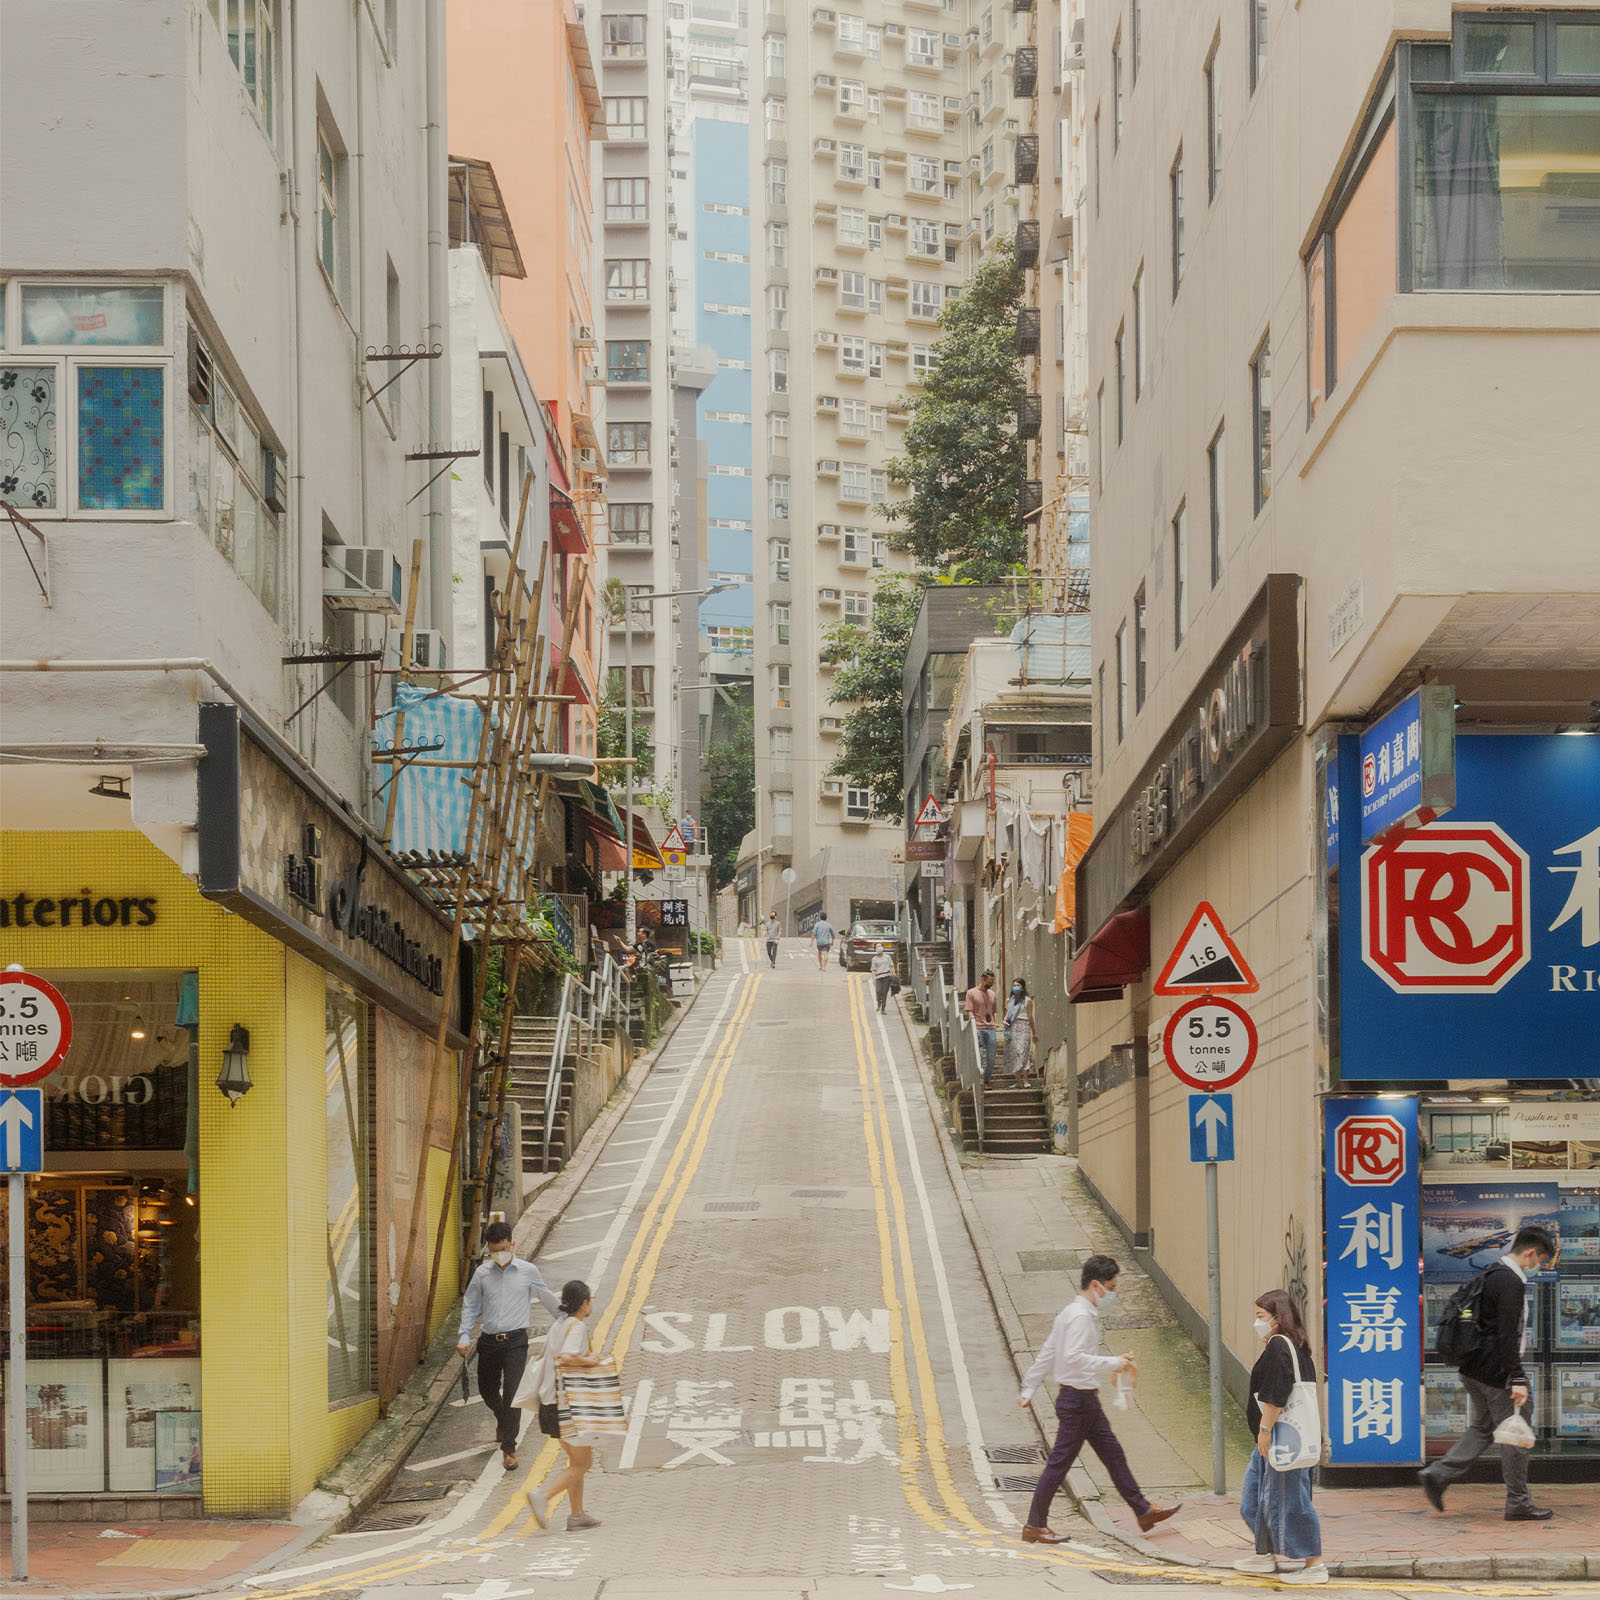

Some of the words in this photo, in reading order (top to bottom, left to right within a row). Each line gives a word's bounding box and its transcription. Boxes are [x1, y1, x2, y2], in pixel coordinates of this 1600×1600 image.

[1378, 719, 1419, 786] 利嘉閣
[1389, 771, 1419, 800] PROPERTIES
[1190, 946, 1217, 968] 1:6
[1547, 965, 1600, 992] RI
[1189, 1017, 1231, 1038] 5.5
[1189, 1045, 1231, 1055] tonnes
[1195, 1060, 1226, 1074] 公噸
[640, 1306, 891, 1354] SLOW
[1338, 1202, 1407, 1445] 利嘉閣
[618, 1378, 902, 1469] 慢駛
